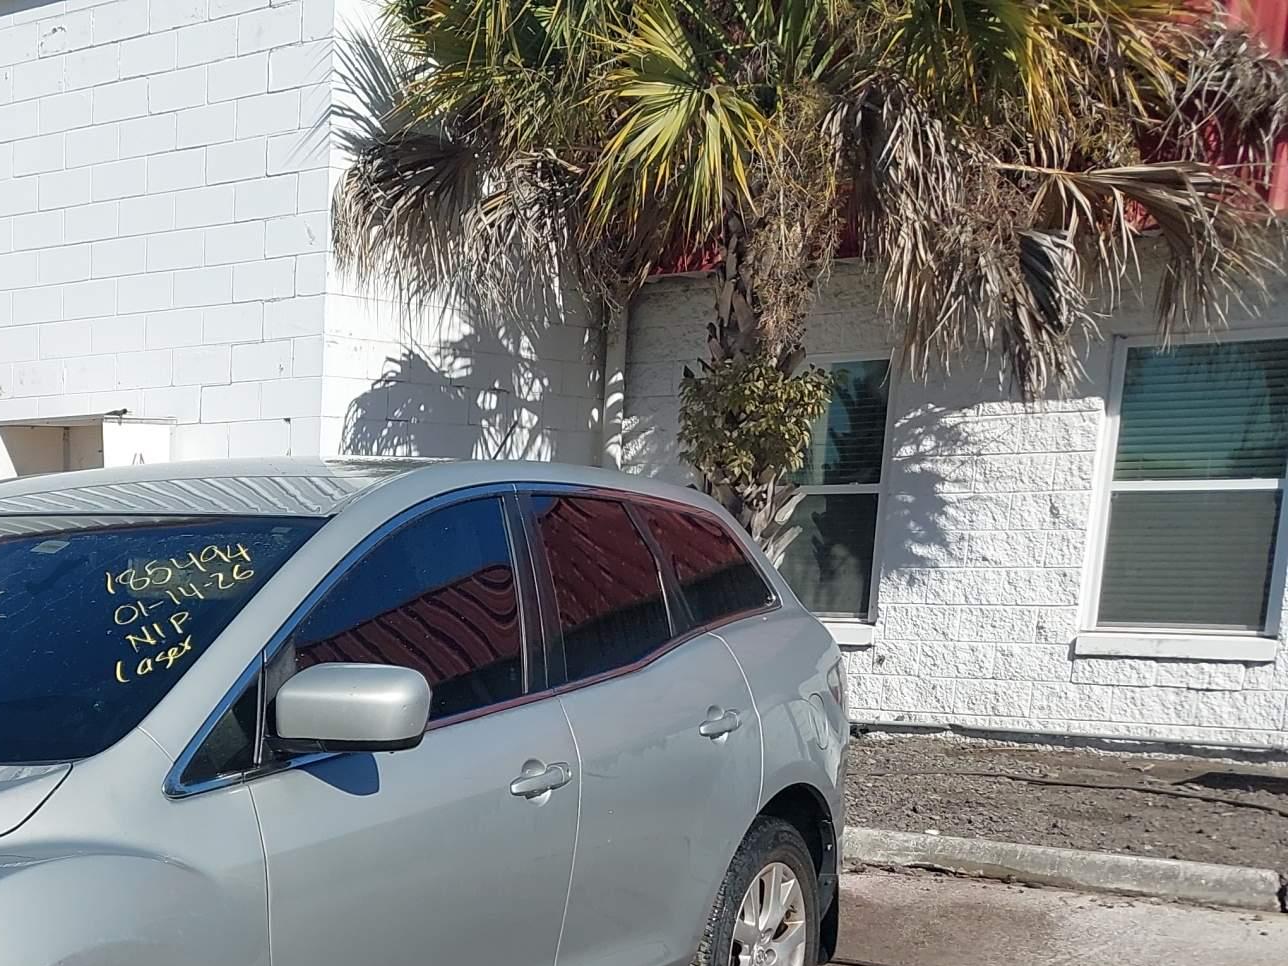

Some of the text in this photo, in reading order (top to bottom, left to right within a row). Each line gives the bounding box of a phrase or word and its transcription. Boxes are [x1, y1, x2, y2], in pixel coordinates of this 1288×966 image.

[106, 543, 251, 594] 185494
[114, 565, 254, 625] 01-14-26
[125, 611, 192, 652] NIP
